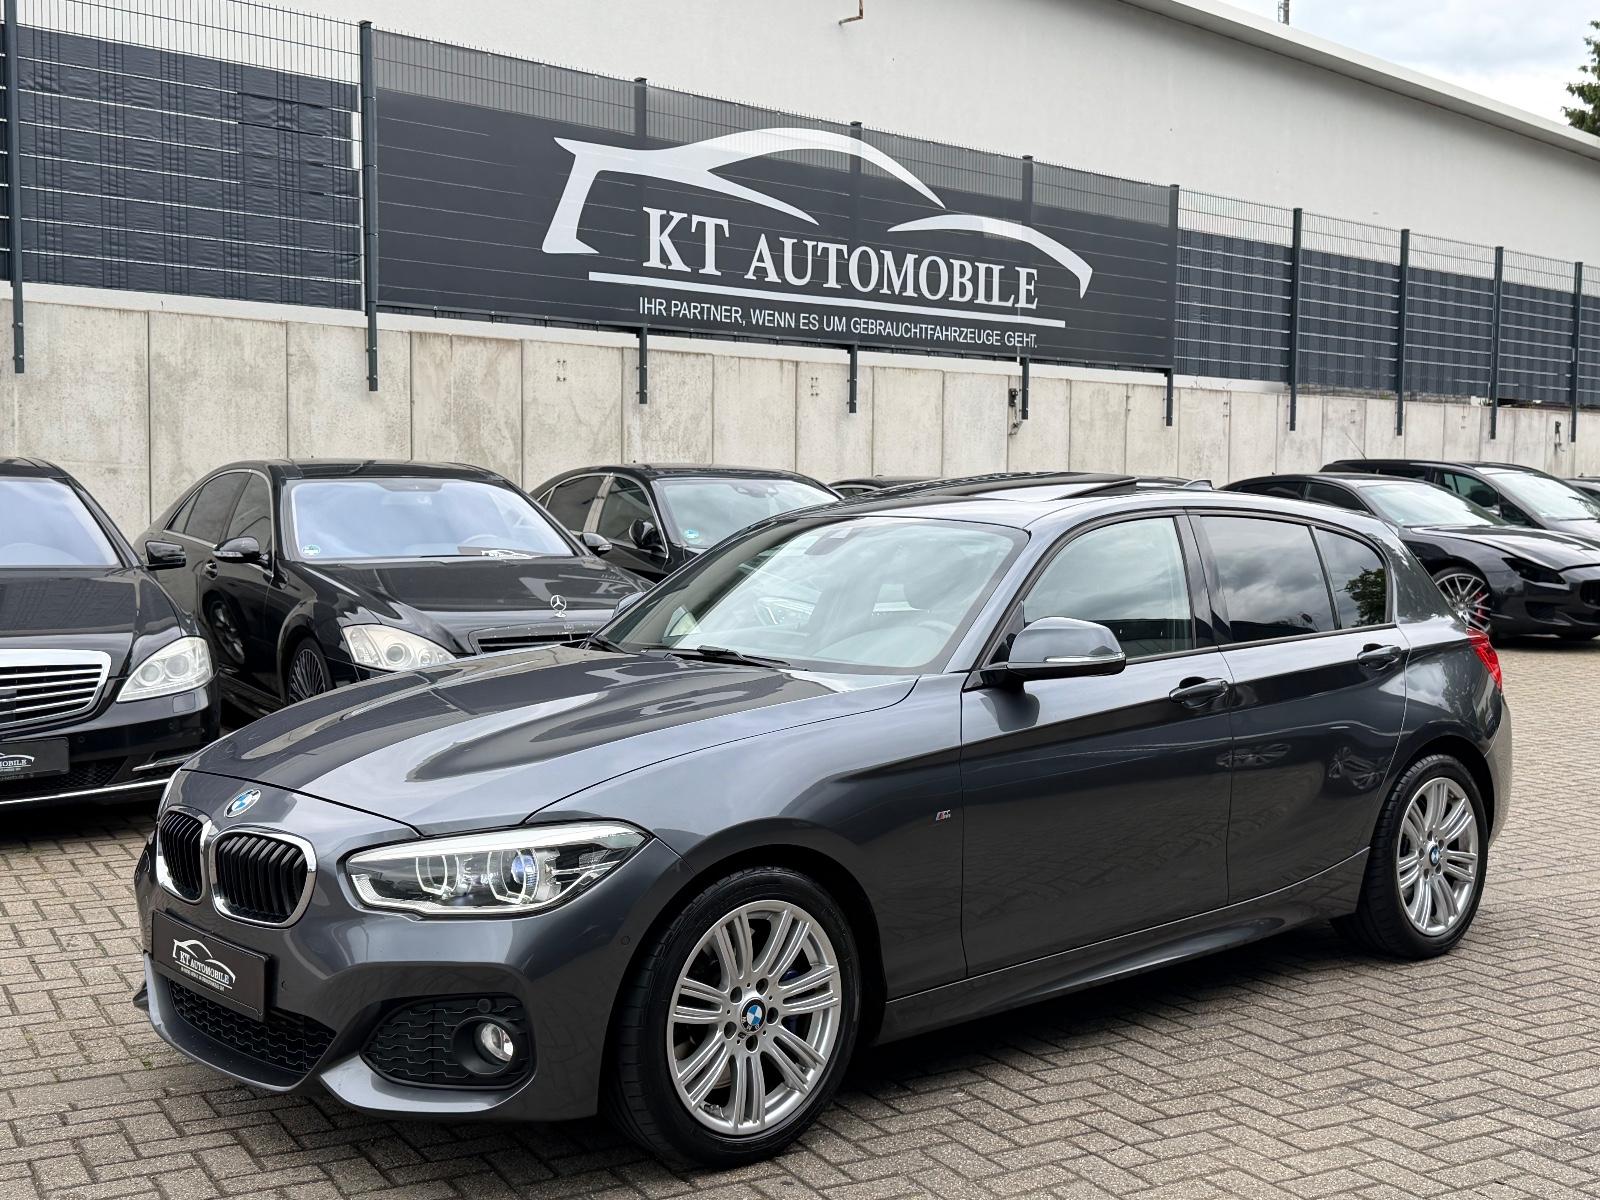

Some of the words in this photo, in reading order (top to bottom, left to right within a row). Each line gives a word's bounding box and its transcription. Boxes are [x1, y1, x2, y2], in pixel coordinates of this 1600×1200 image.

[643, 206, 730, 276] KT
[744, 233, 1038, 310] AUTOMOBILE
[639, 296, 667, 316] IHR
[671, 300, 746, 326] PARTNER,
[750, 308, 795, 329] WENN
[799, 313, 819, 331] ES
[823, 315, 846, 333] UM
[850, 317, 1001, 346] GEBRAUCHTFAHRZEUGE
[1004, 331, 1038, 349] GEHT.
[180, 951, 190, 965] KT
[190, 959, 229, 984] AUTOMOBILE
